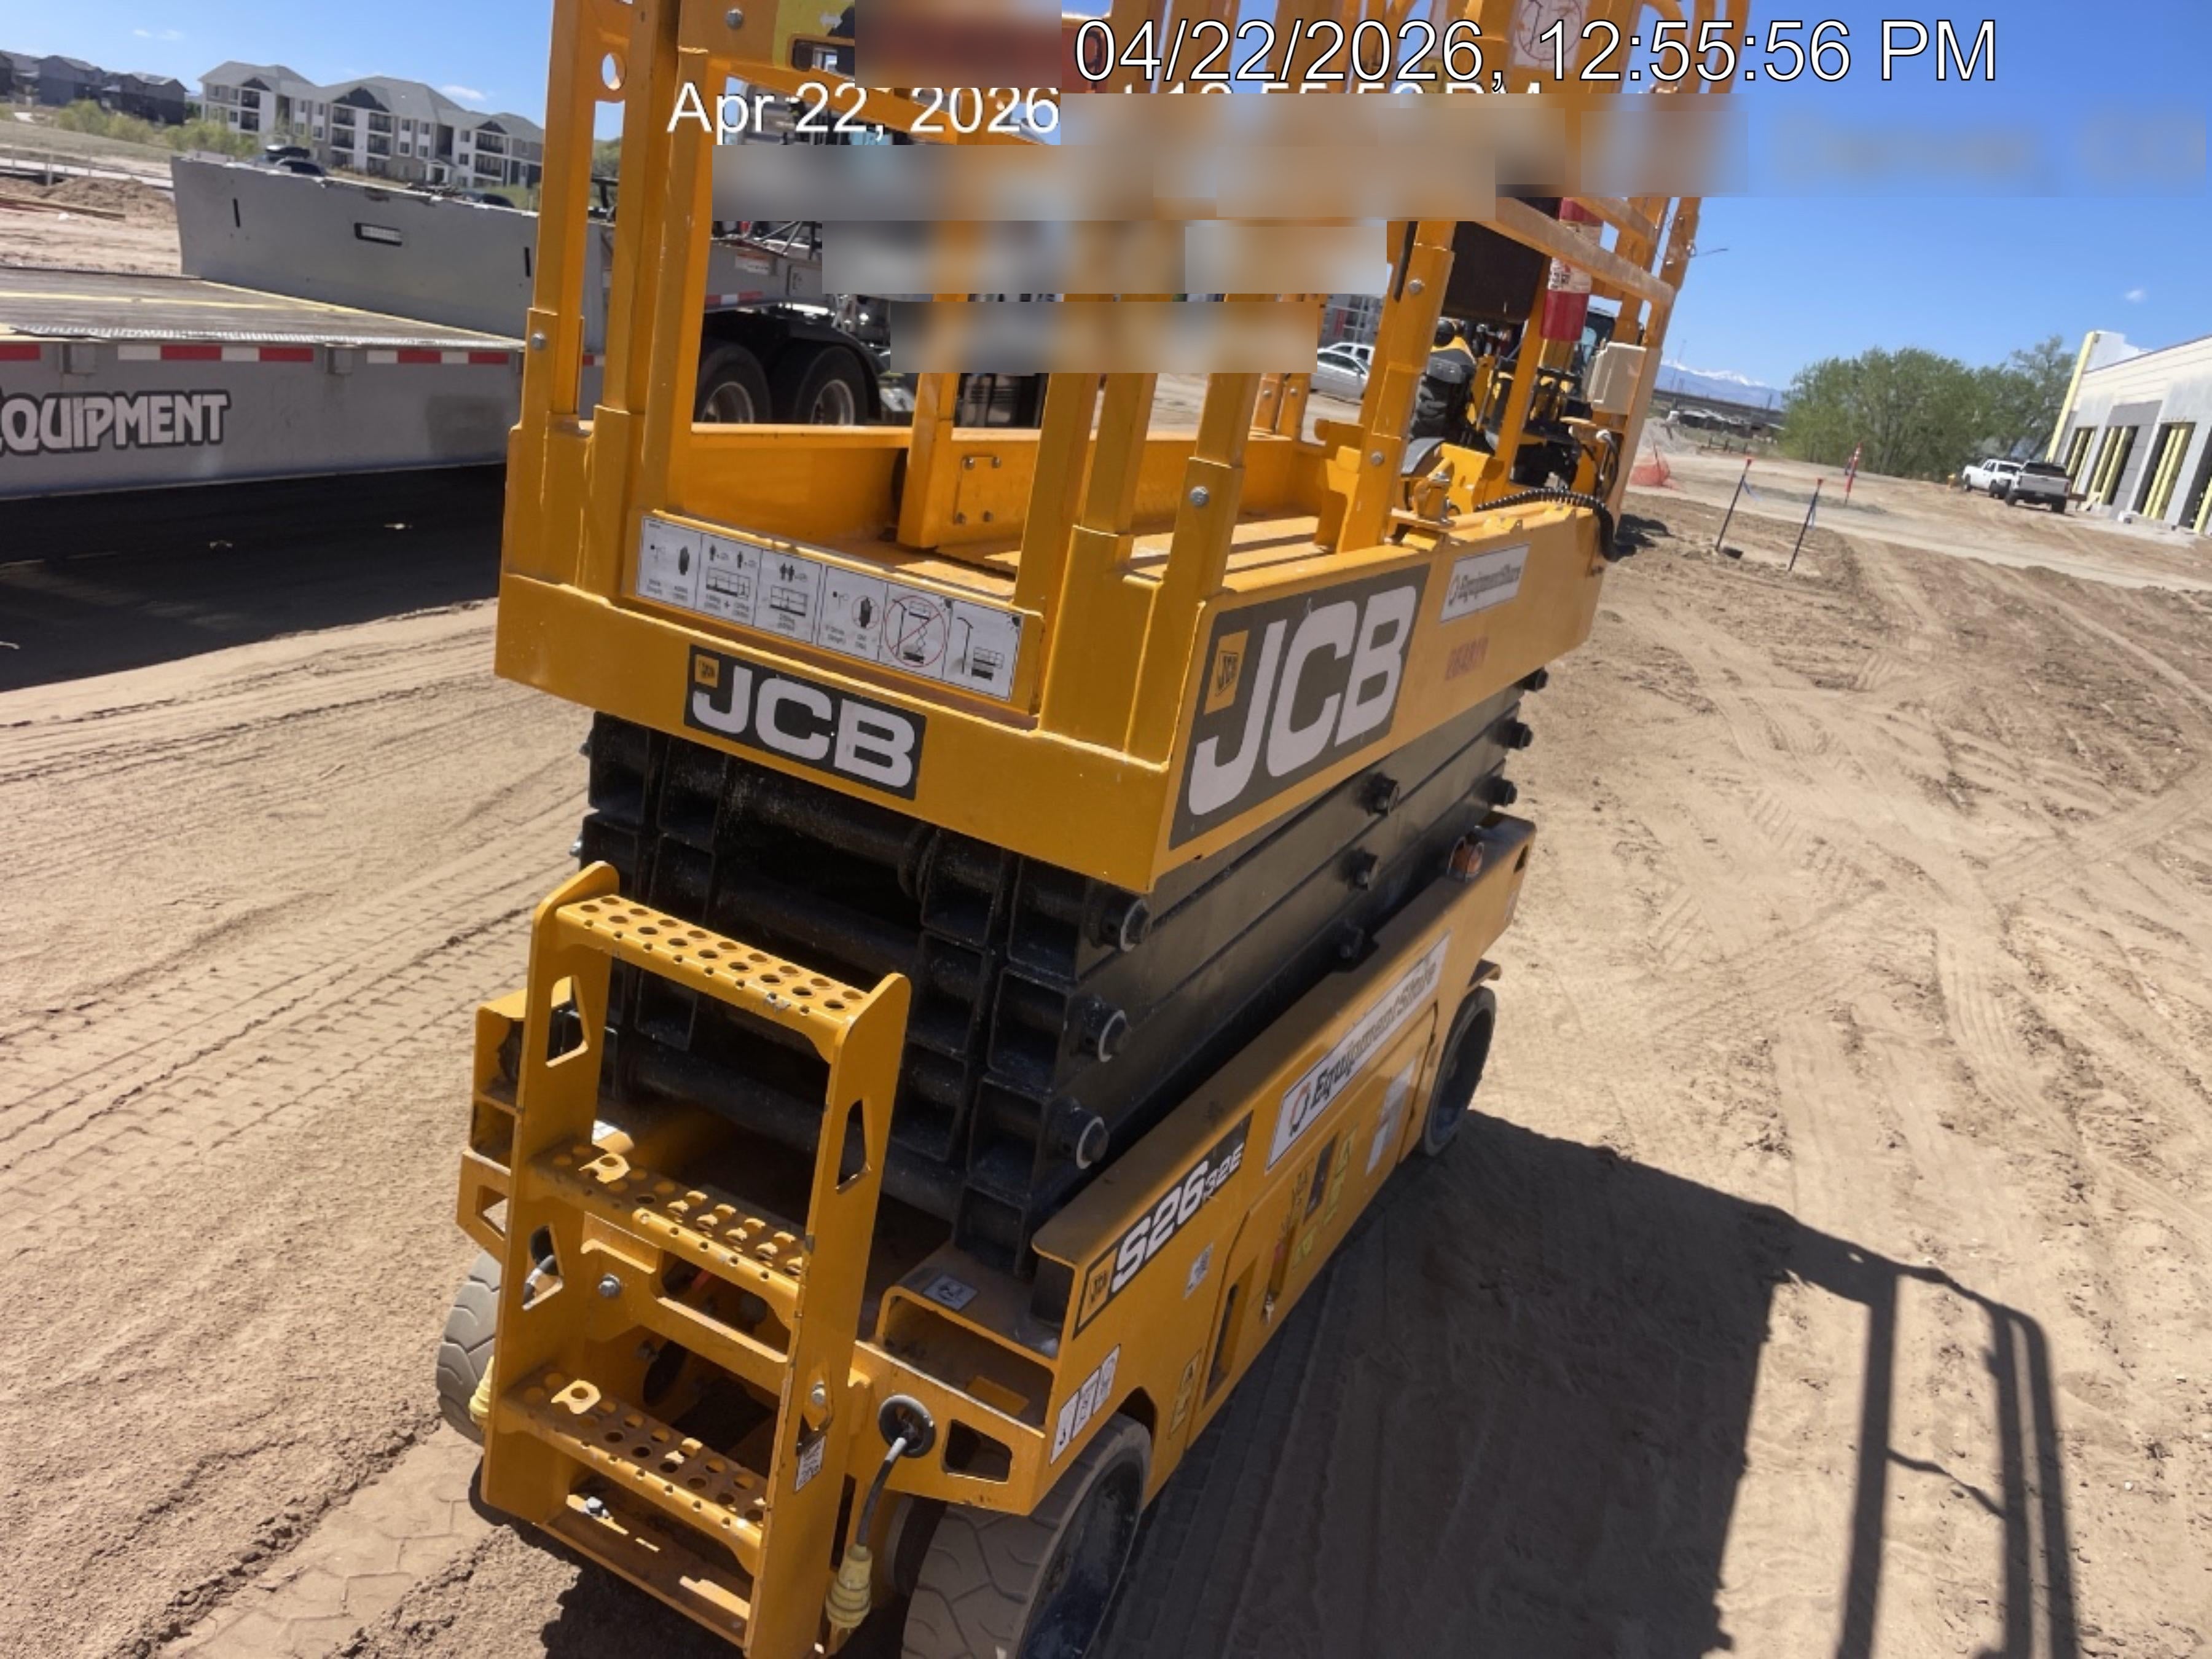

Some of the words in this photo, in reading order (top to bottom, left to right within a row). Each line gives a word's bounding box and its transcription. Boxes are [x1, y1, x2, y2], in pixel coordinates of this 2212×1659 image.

[0, 394, 229, 452] QUIPMENT
[693, 665, 916, 788] JCB
[1188, 585, 1418, 816] JCB
